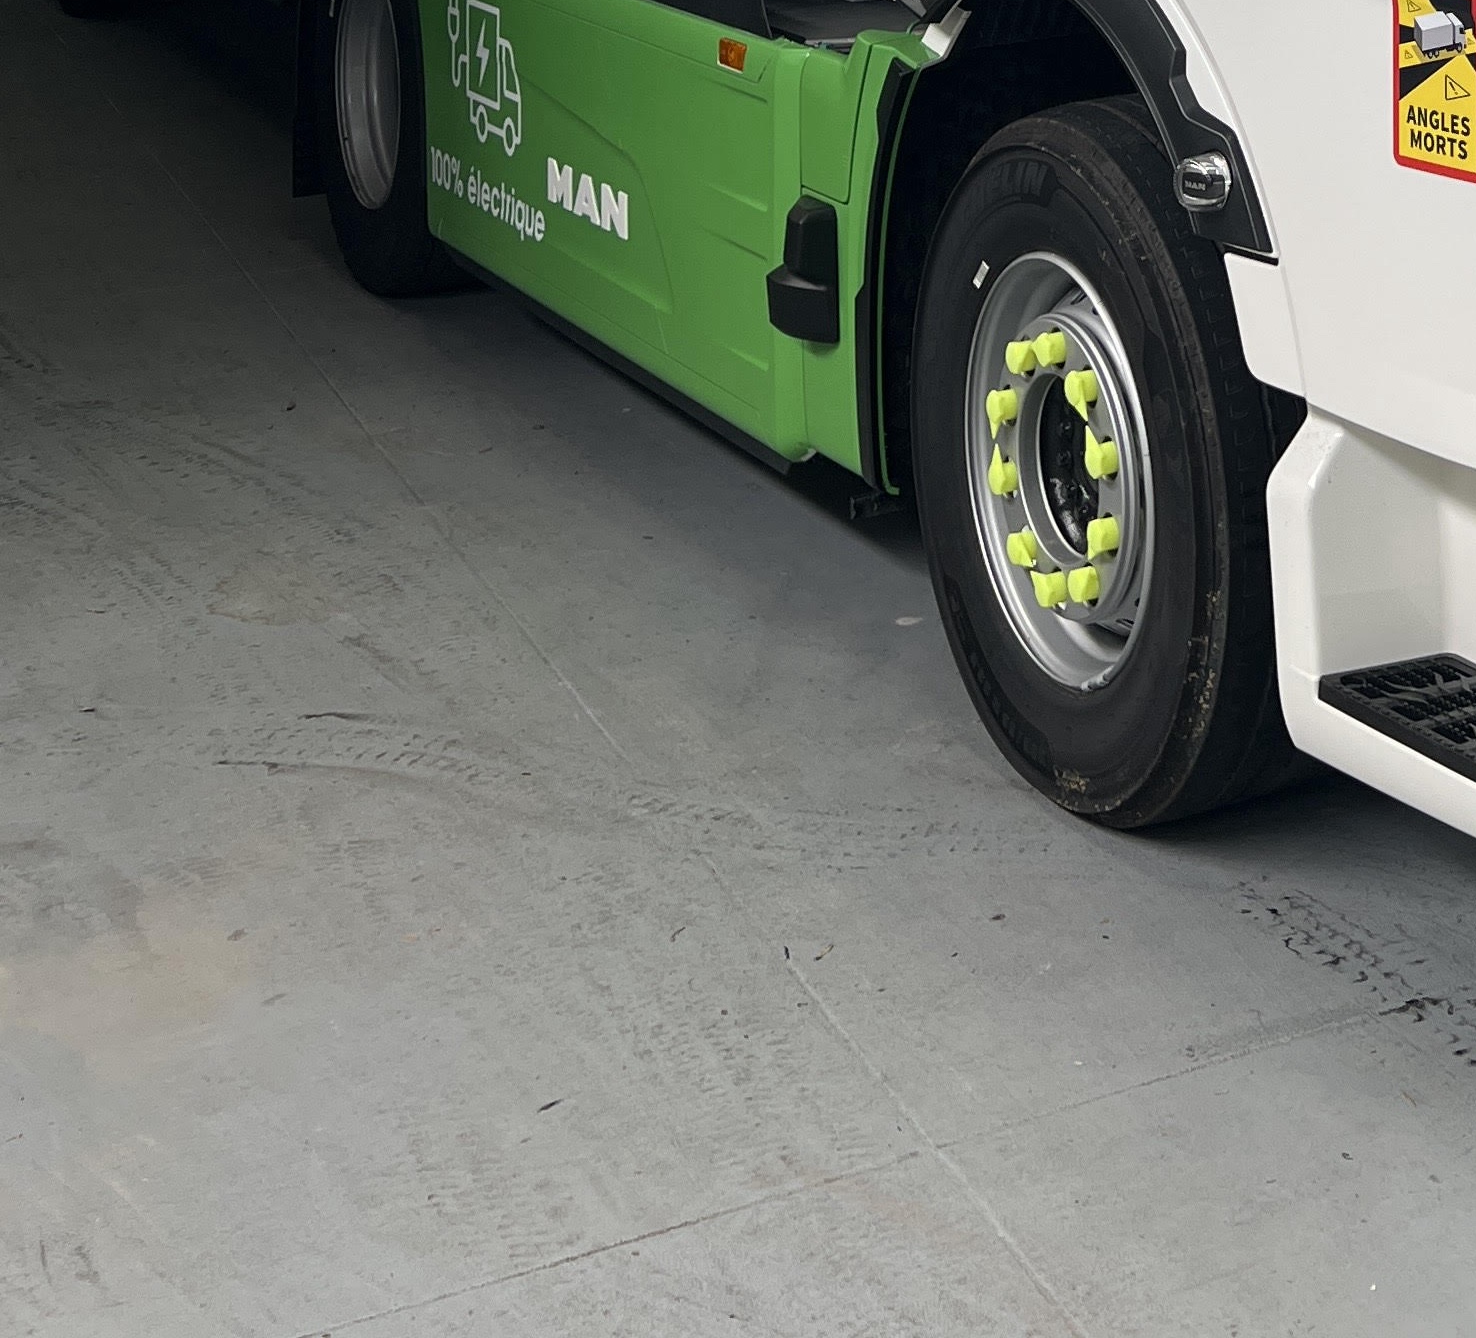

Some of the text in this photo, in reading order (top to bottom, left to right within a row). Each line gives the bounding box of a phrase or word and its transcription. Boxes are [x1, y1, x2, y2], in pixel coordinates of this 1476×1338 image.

[1406, 105, 1471, 137] ANGLES
[1410, 128, 1468, 160] MORTS
[431, 146, 546, 242] 100% électrique
[547, 156, 629, 240] MAN
[1184, 179, 1206, 191] MAN
